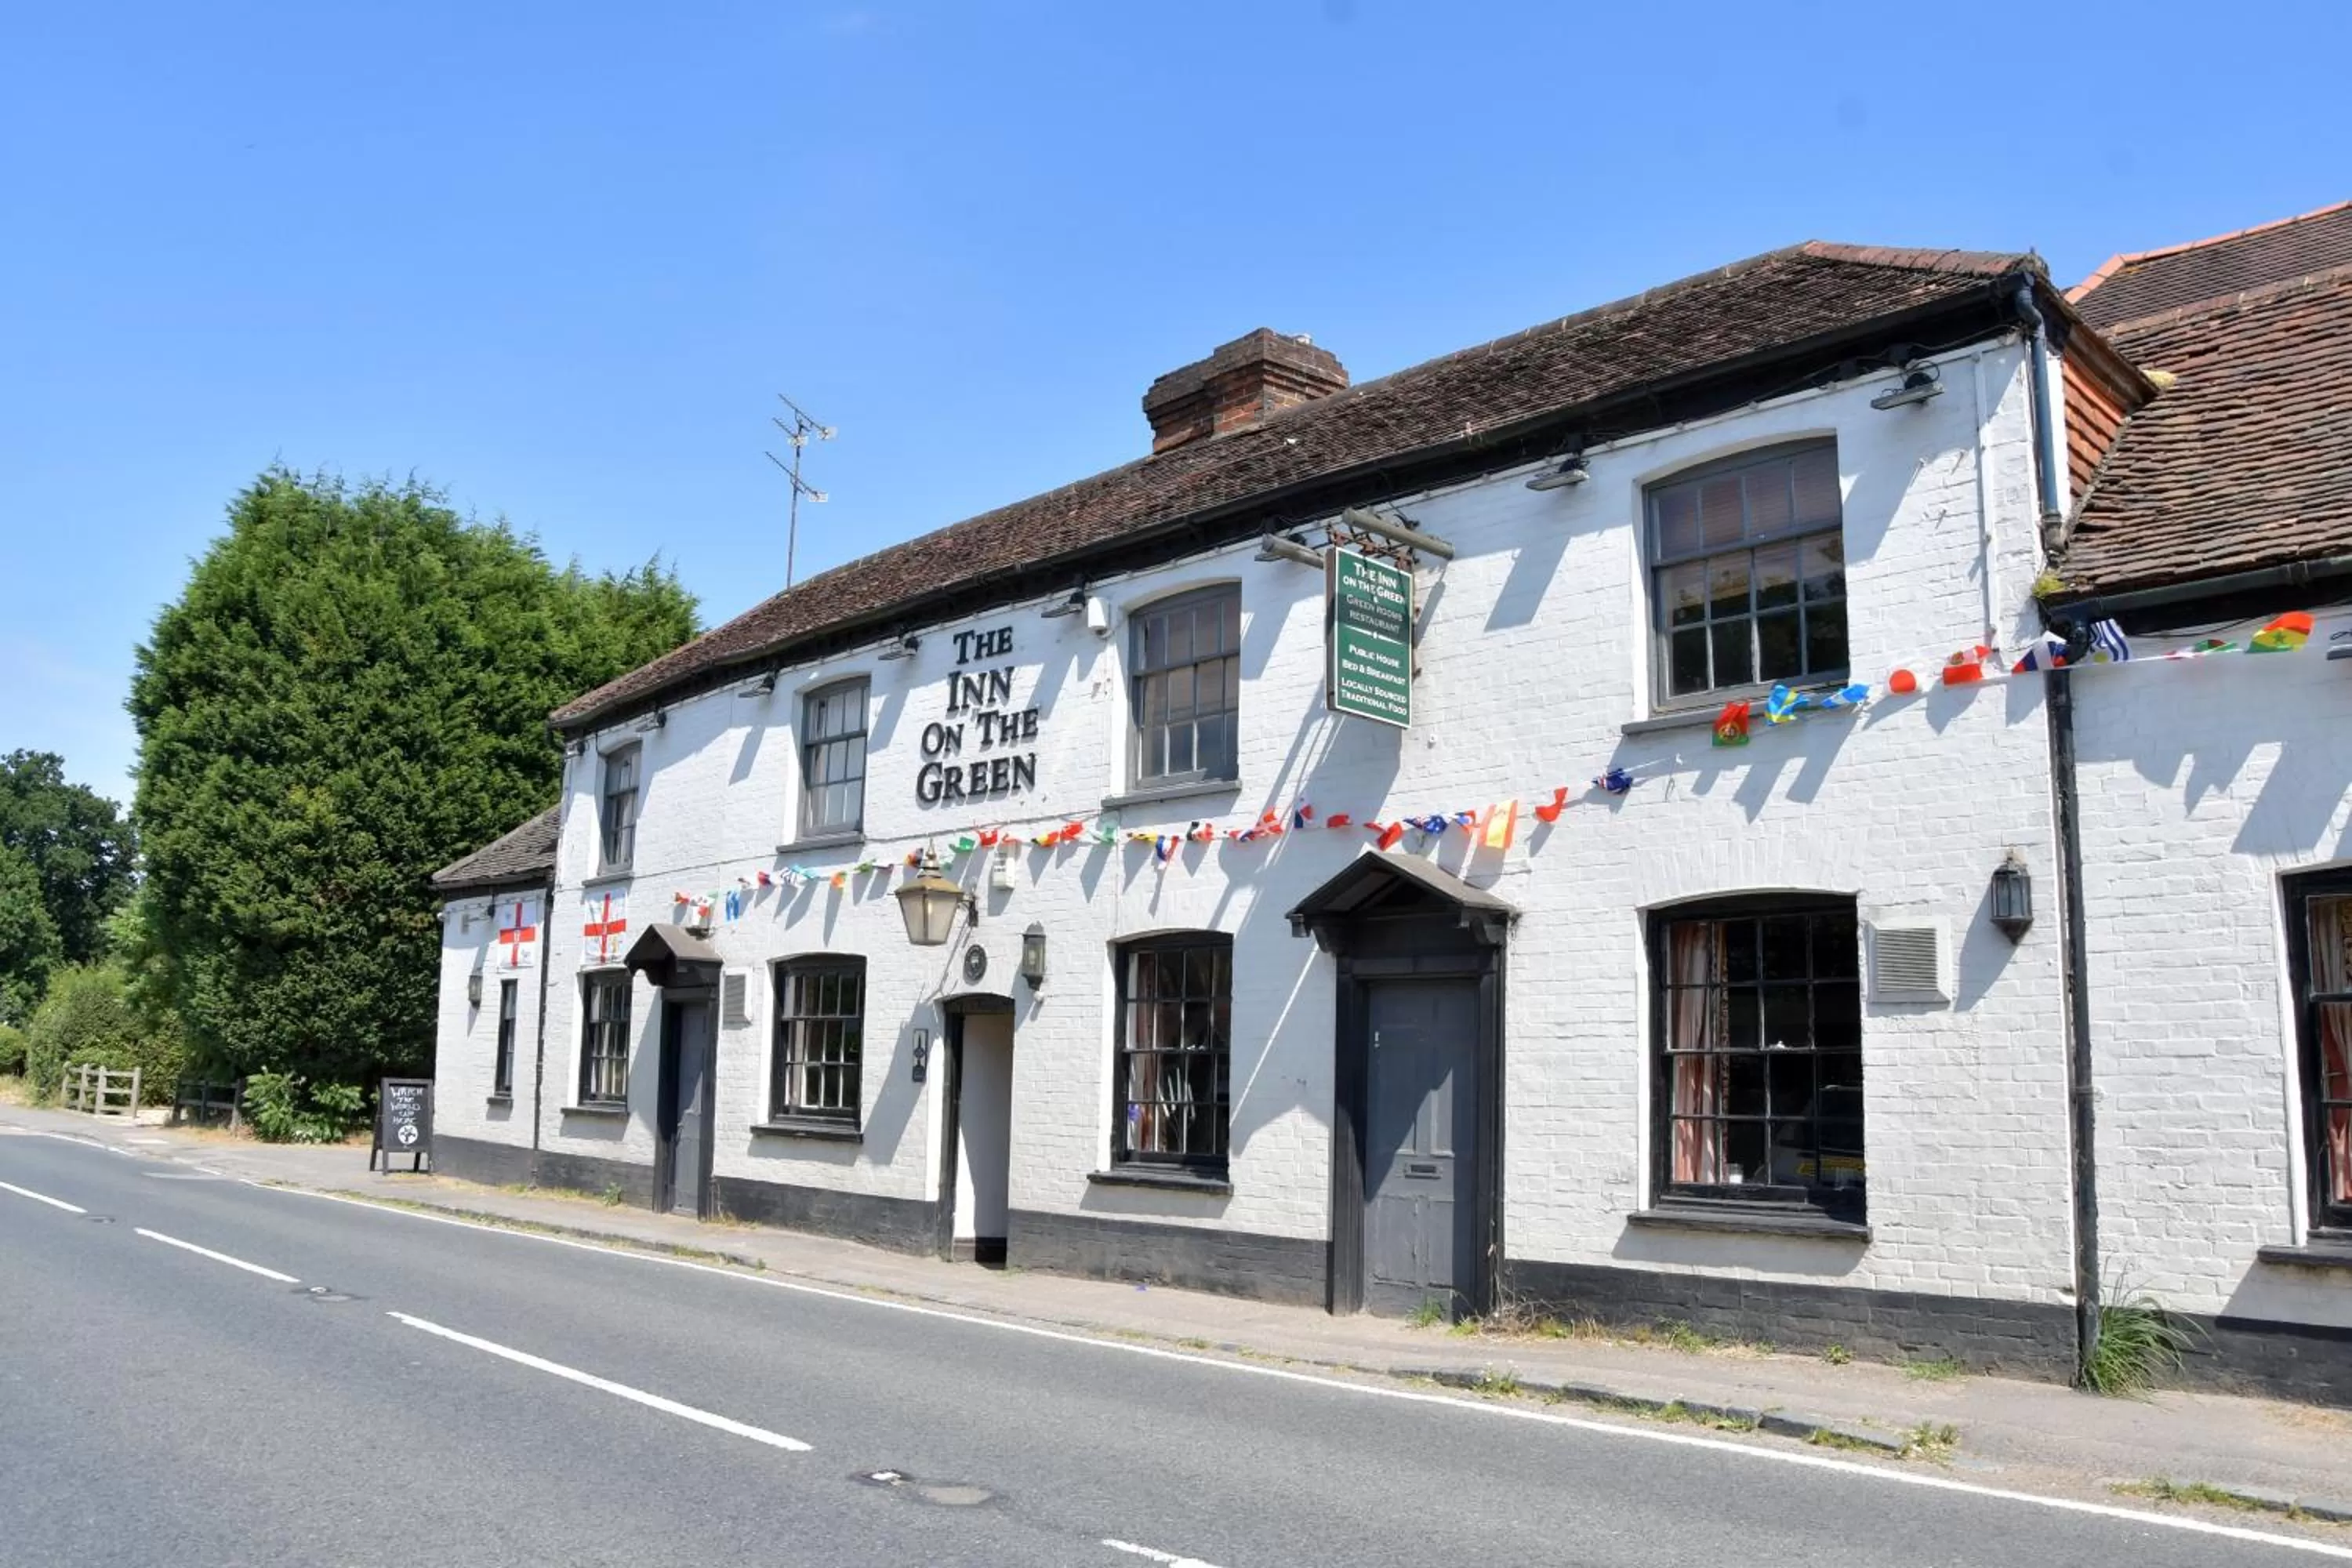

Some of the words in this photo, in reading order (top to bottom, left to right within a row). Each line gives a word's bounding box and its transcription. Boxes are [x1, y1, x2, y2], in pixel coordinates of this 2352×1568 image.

[1353, 562, 1376, 582] THE
[1378, 571, 1397, 590] INN
[1342, 575, 1356, 587] ON
[1358, 580, 1376, 595] THE
[1377, 585, 1406, 605] GREEN
[1346, 593, 1374, 612] GREEN
[1348, 610, 1399, 634] RESTAURANT
[953, 626, 1014, 665] THE
[1349, 644, 1376, 661] PUBLIC
[1376, 653, 1399, 669] HOUSE
[1341, 659, 1358, 672] BED
[1367, 666, 1406, 686] BREAKFAST
[946, 666, 1015, 712] INN
[1341, 677, 1373, 694] LOCALLY
[1374, 686, 1407, 704] SOURCED
[1341, 689, 1387, 710] TRADITIONAL
[1388, 702, 1407, 716] FOOD
[921, 722, 964, 756] ON
[977, 708, 1040, 746] THE
[916, 753, 1036, 803] GREEN
